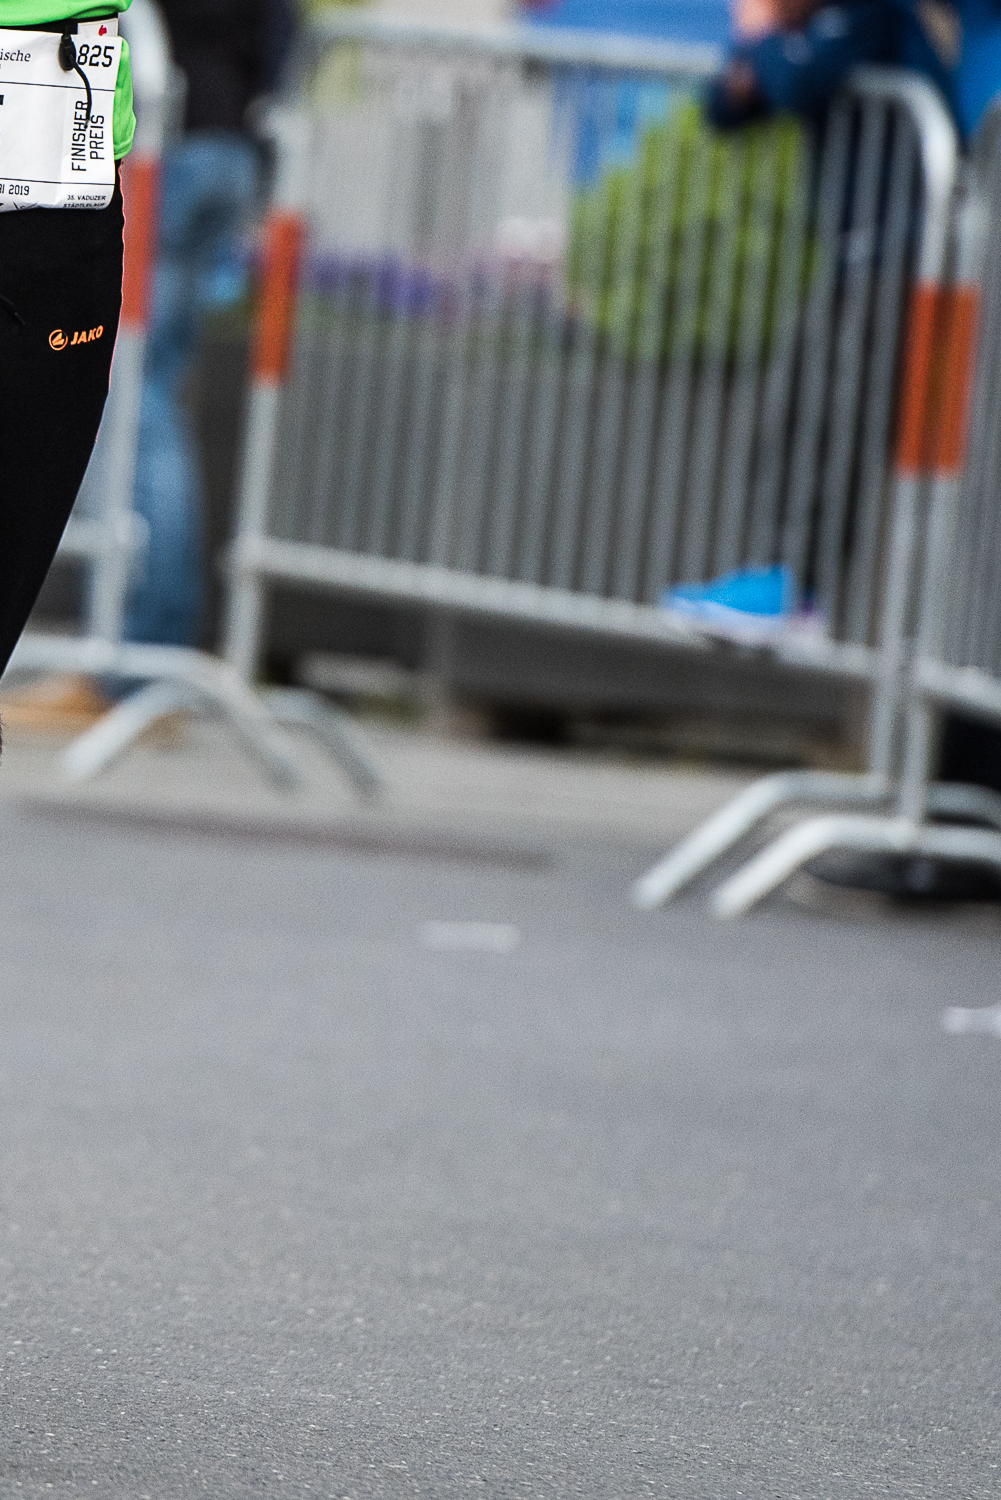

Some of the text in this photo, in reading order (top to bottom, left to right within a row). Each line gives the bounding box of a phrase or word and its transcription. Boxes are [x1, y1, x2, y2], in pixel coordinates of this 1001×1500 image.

[77, 43, 115, 69] 825
[71, 99, 89, 172] FINISHER
[90, 114, 105, 160] PREIS
[8, 184, 30, 196] 2019
[70, 324, 104, 346] JAKO
